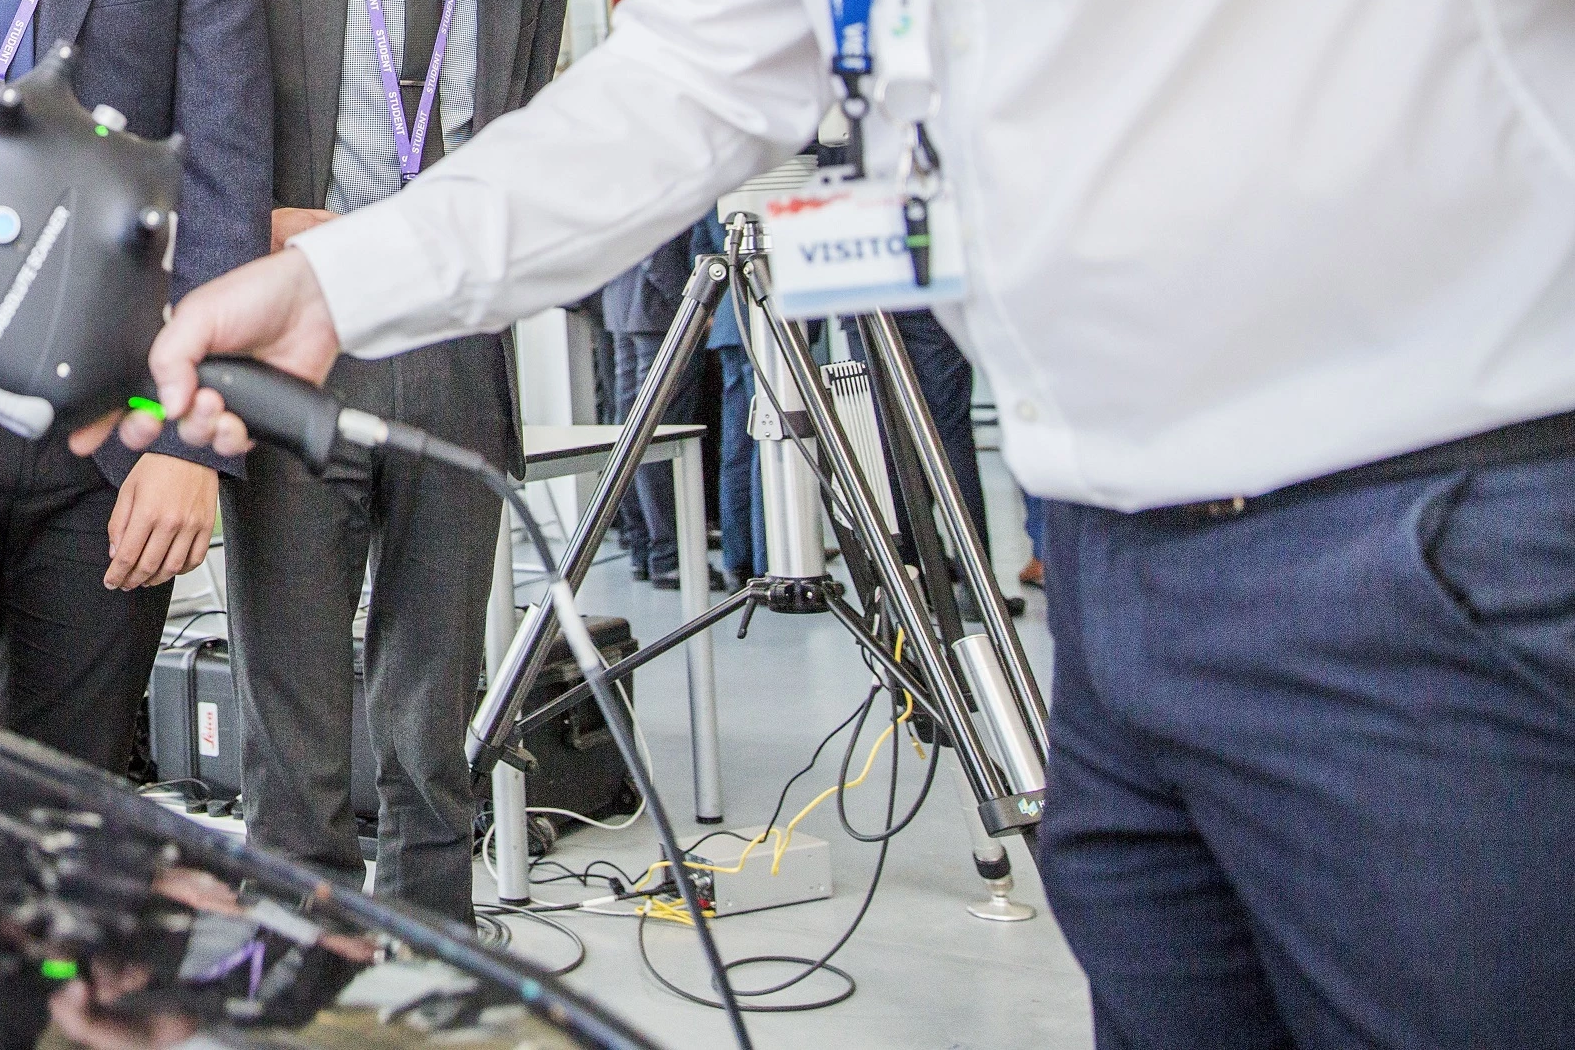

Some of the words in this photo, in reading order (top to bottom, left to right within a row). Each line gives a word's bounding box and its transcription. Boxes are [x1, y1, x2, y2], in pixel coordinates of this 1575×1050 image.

[0, 20, 24, 64] STUDENT
[376, 29, 392, 73] STUDENT
[426, 50, 441, 94] STUDENT
[389, 91, 405, 136] STUDENT
[412, 111, 427, 155] STUDENT
[799, 233, 910, 263] VISITO
